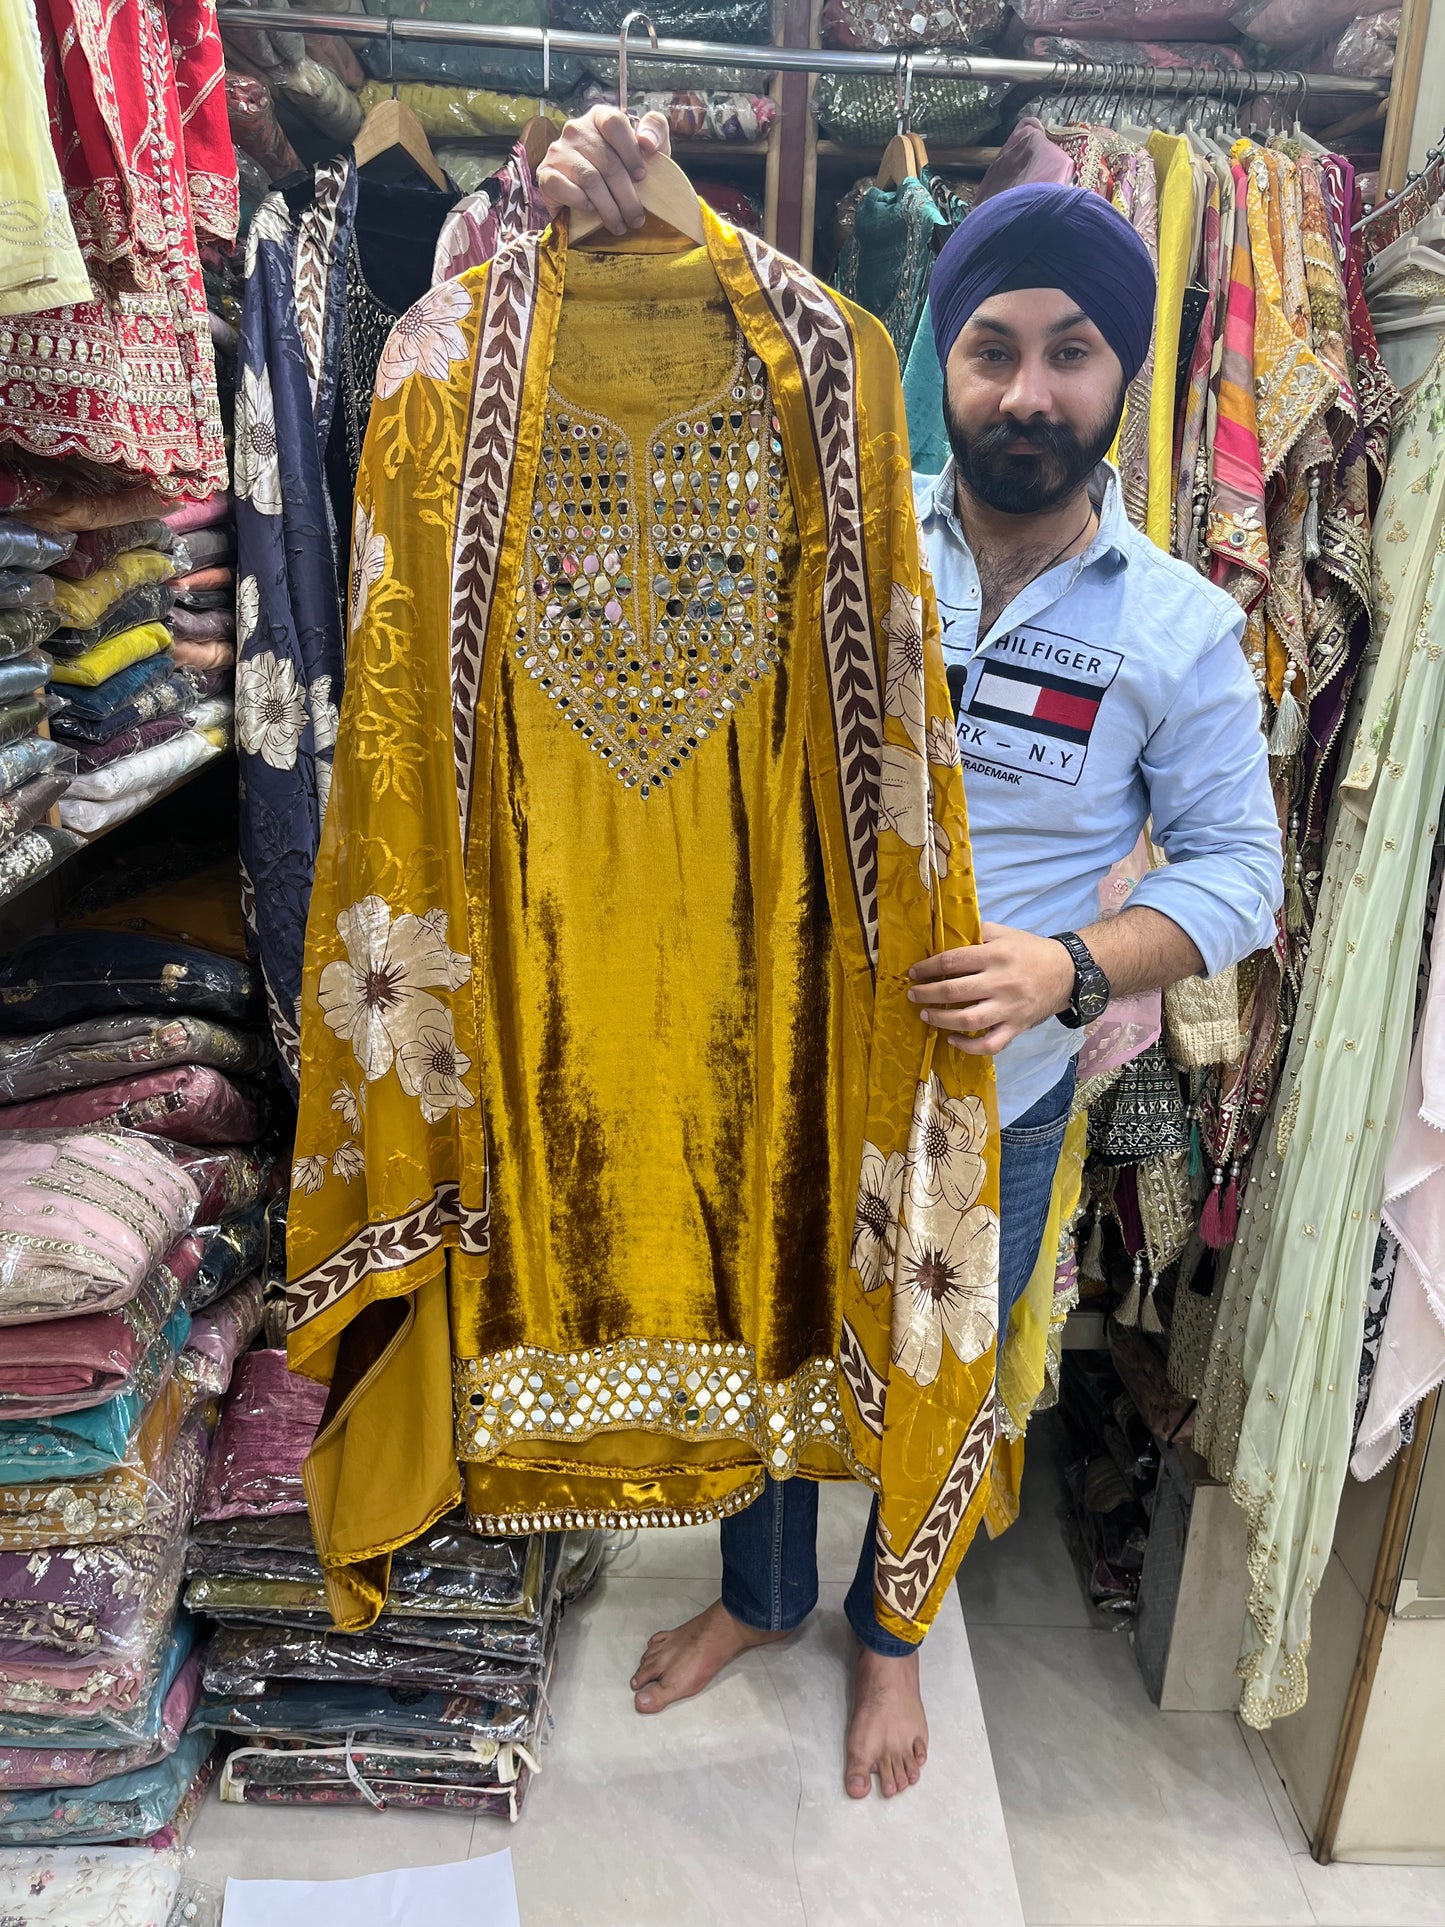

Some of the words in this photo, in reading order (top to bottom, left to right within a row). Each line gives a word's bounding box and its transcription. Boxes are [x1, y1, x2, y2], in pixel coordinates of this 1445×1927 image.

[995, 635, 1102, 673] HILFIGER
[1028, 743, 1074, 769] N.Y
[960, 758, 1023, 786] TRADEMARK
